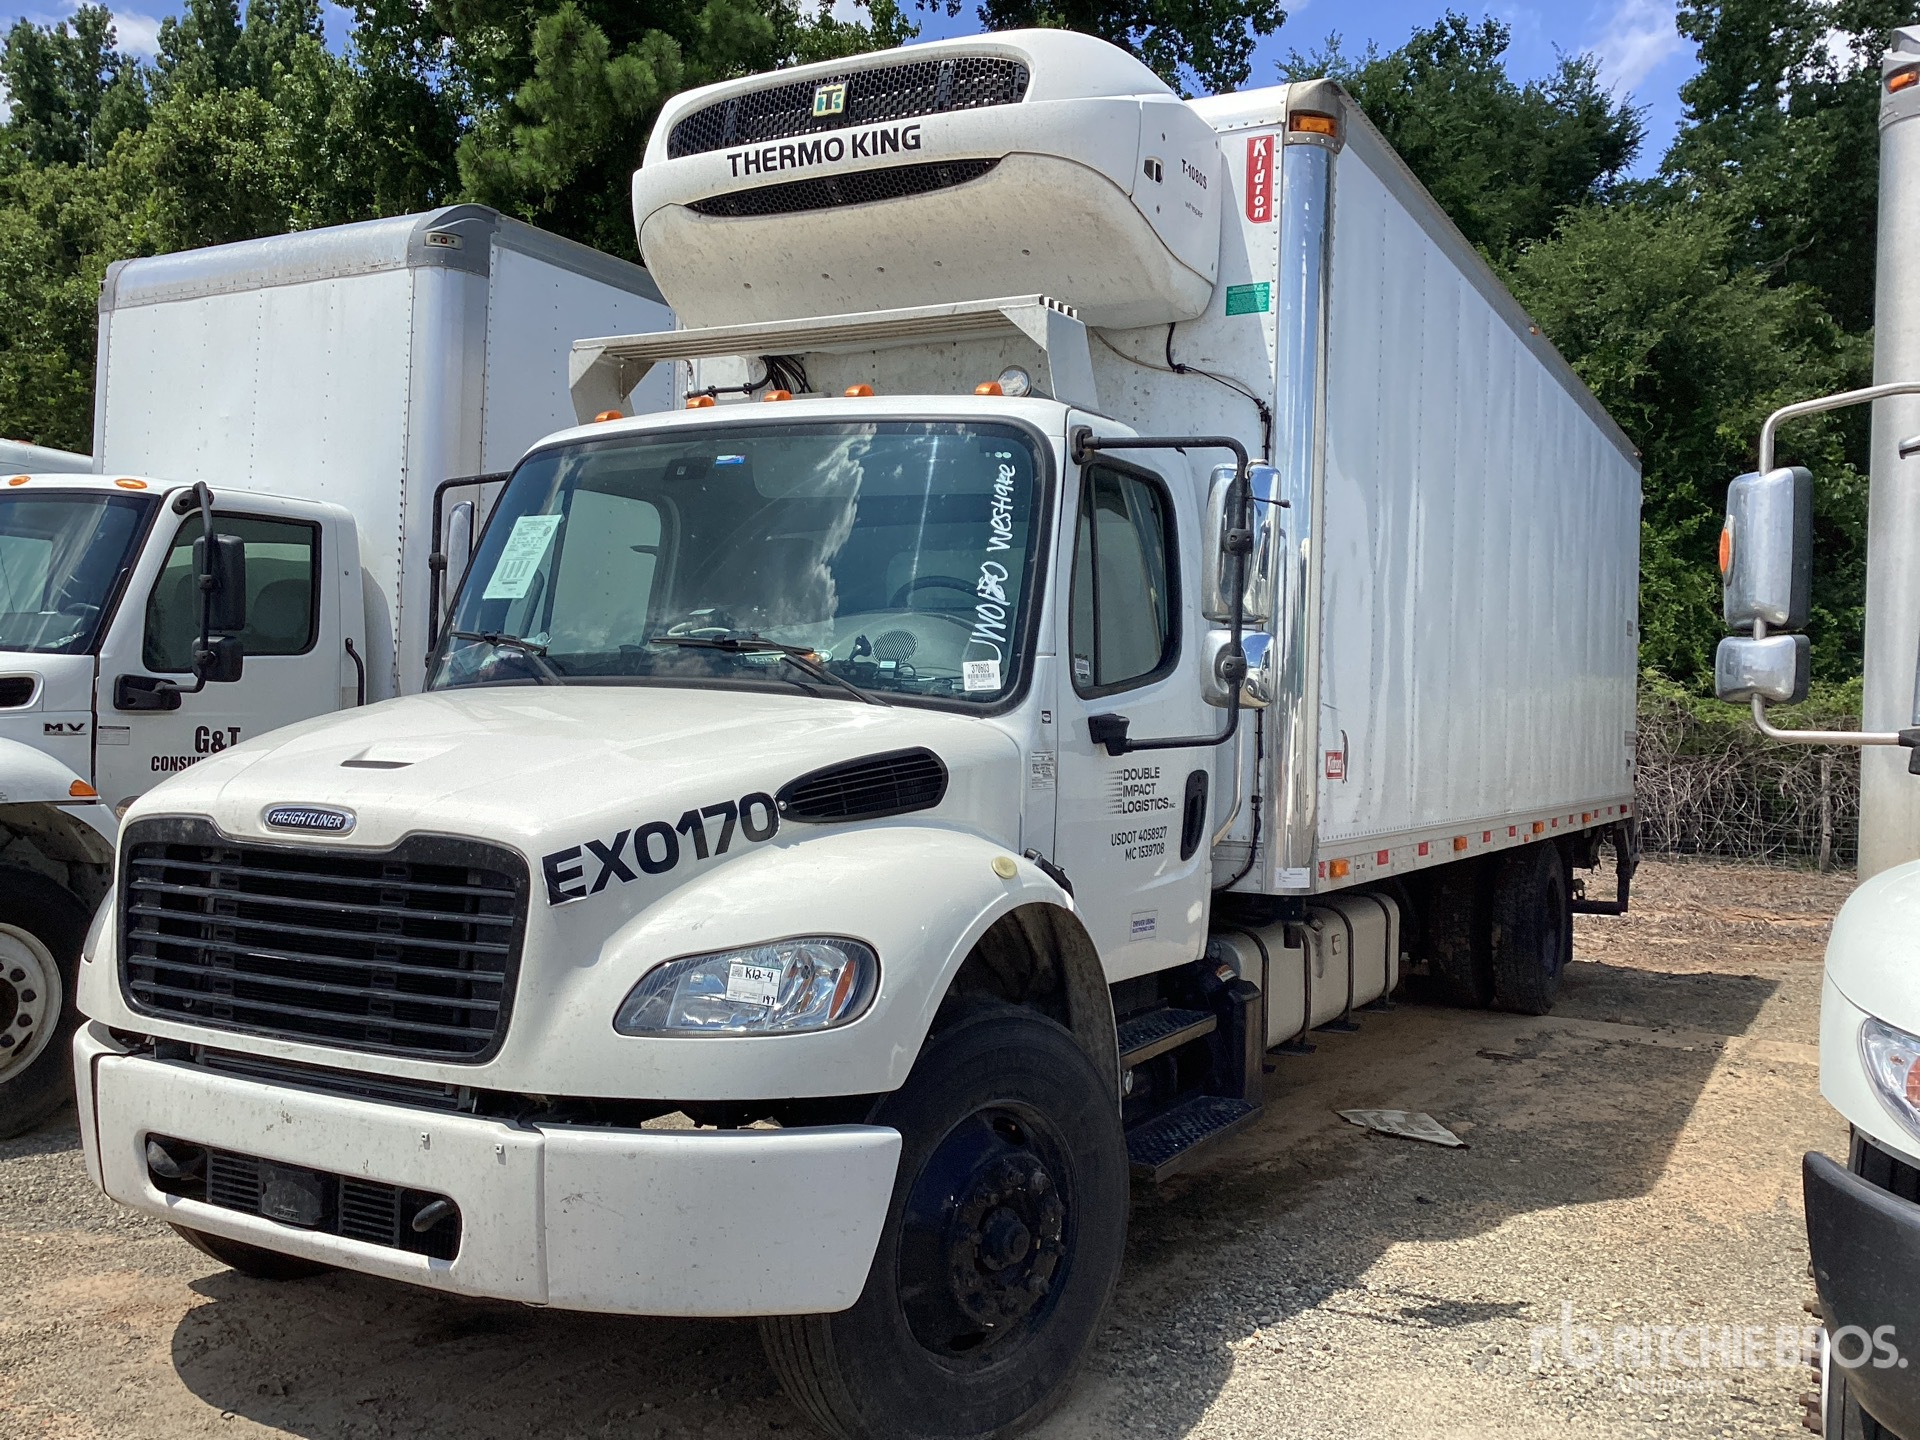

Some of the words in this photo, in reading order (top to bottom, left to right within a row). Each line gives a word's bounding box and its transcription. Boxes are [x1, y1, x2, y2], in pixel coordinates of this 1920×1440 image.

[727, 136, 845, 177] THERMO
[851, 124, 921, 159] KING
[1181, 158, 1208, 190] T-1080S
[1253, 138, 1267, 218] Kidron
[44, 723, 85, 732] MV
[194, 725, 241, 754] G&T
[1123, 766, 1160, 781] DOUBLE
[1122, 782, 1157, 798] IMPACT
[1122, 797, 1169, 814] LOGISTICS
[270, 811, 344, 828] FREIGHTLINER
[1111, 830, 1138, 846] USDOT
[1138, 826, 1168, 841] 4058927
[1125, 847, 1137, 861] MC
[1138, 842, 1165, 859] 1539708
[745, 967, 774, 982] K12-4
